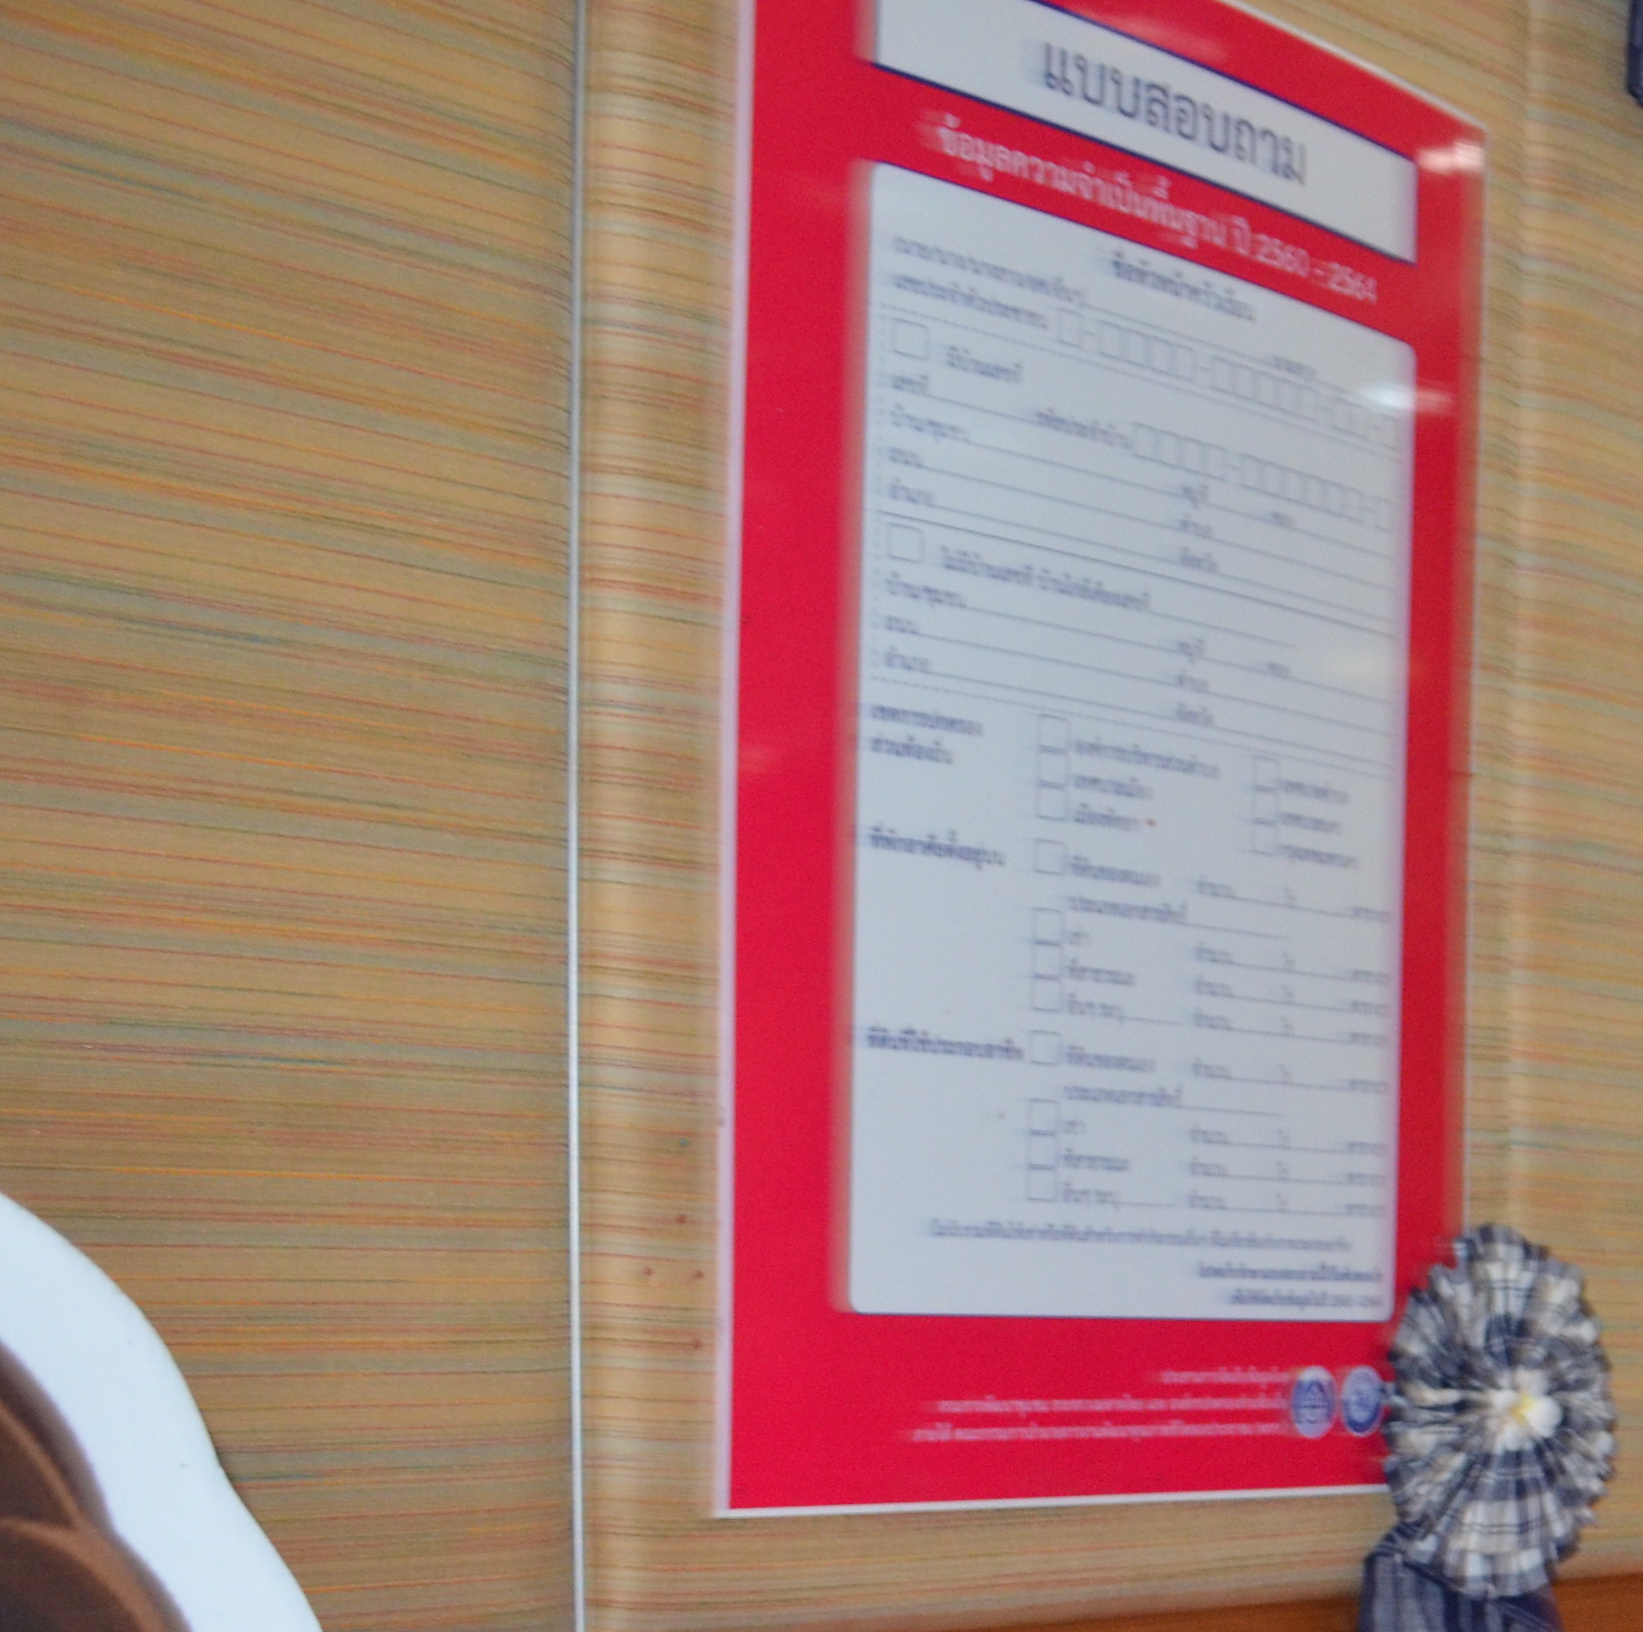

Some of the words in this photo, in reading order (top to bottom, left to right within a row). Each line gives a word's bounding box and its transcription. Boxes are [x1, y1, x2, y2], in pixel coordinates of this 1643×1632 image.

[1042, 40, 1307, 188] แบบสอบถาม
[928, 115, 1228, 252] ข้อมูลความจำเป็นพื้นฐาน
[1229, 214, 1252, 258] ปี
[1256, 234, 1310, 278] 2560
[1328, 262, 1379, 304] 2564
